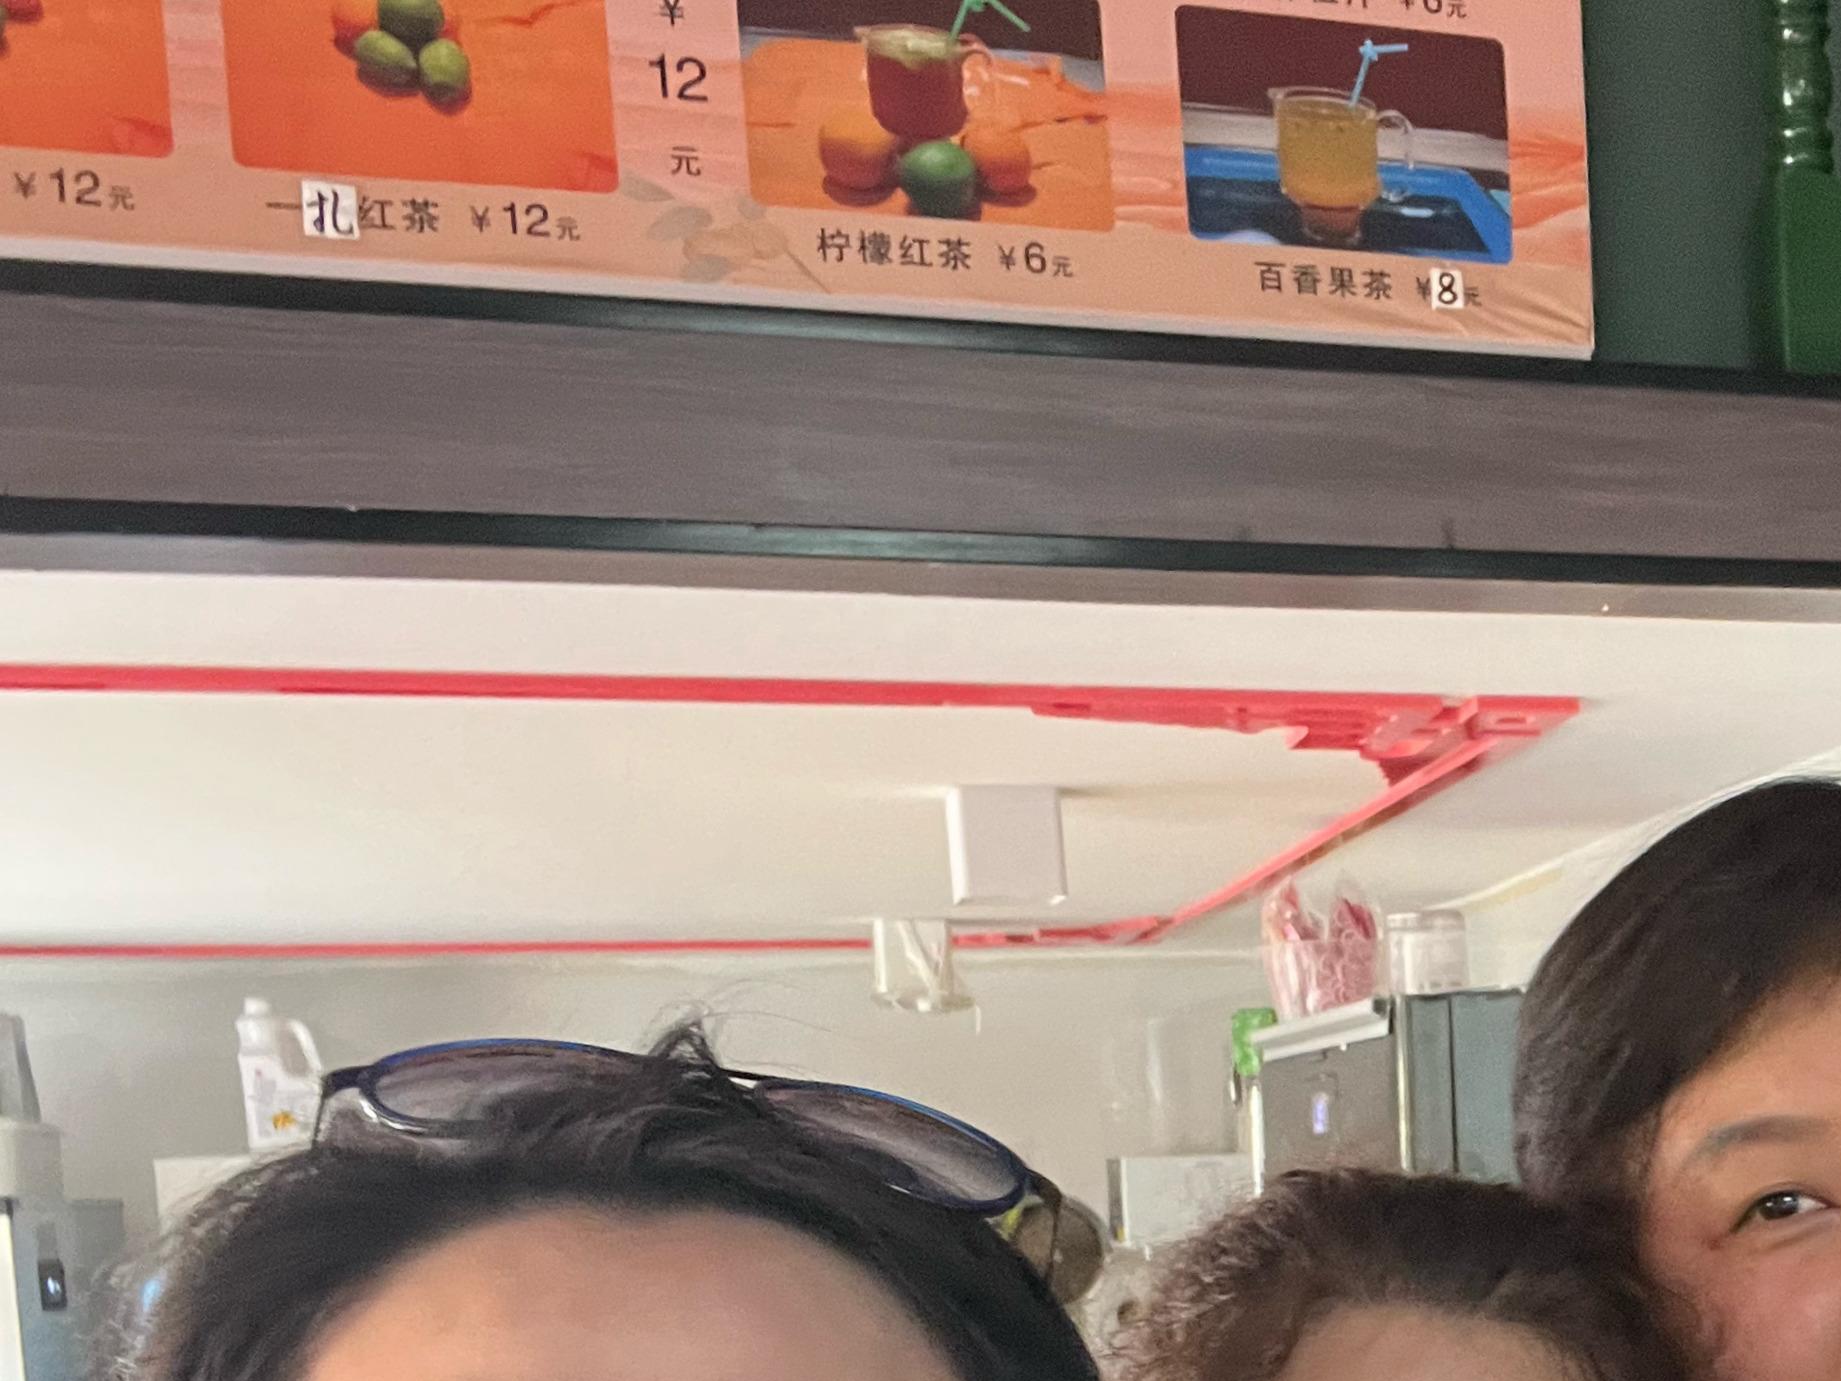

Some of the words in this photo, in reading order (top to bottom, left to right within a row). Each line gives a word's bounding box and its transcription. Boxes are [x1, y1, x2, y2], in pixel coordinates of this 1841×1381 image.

[648, 53, 709, 102] 12
[816, 227, 971, 271] 柠檬红茶
[1254, 261, 1393, 300] 百香果茶
